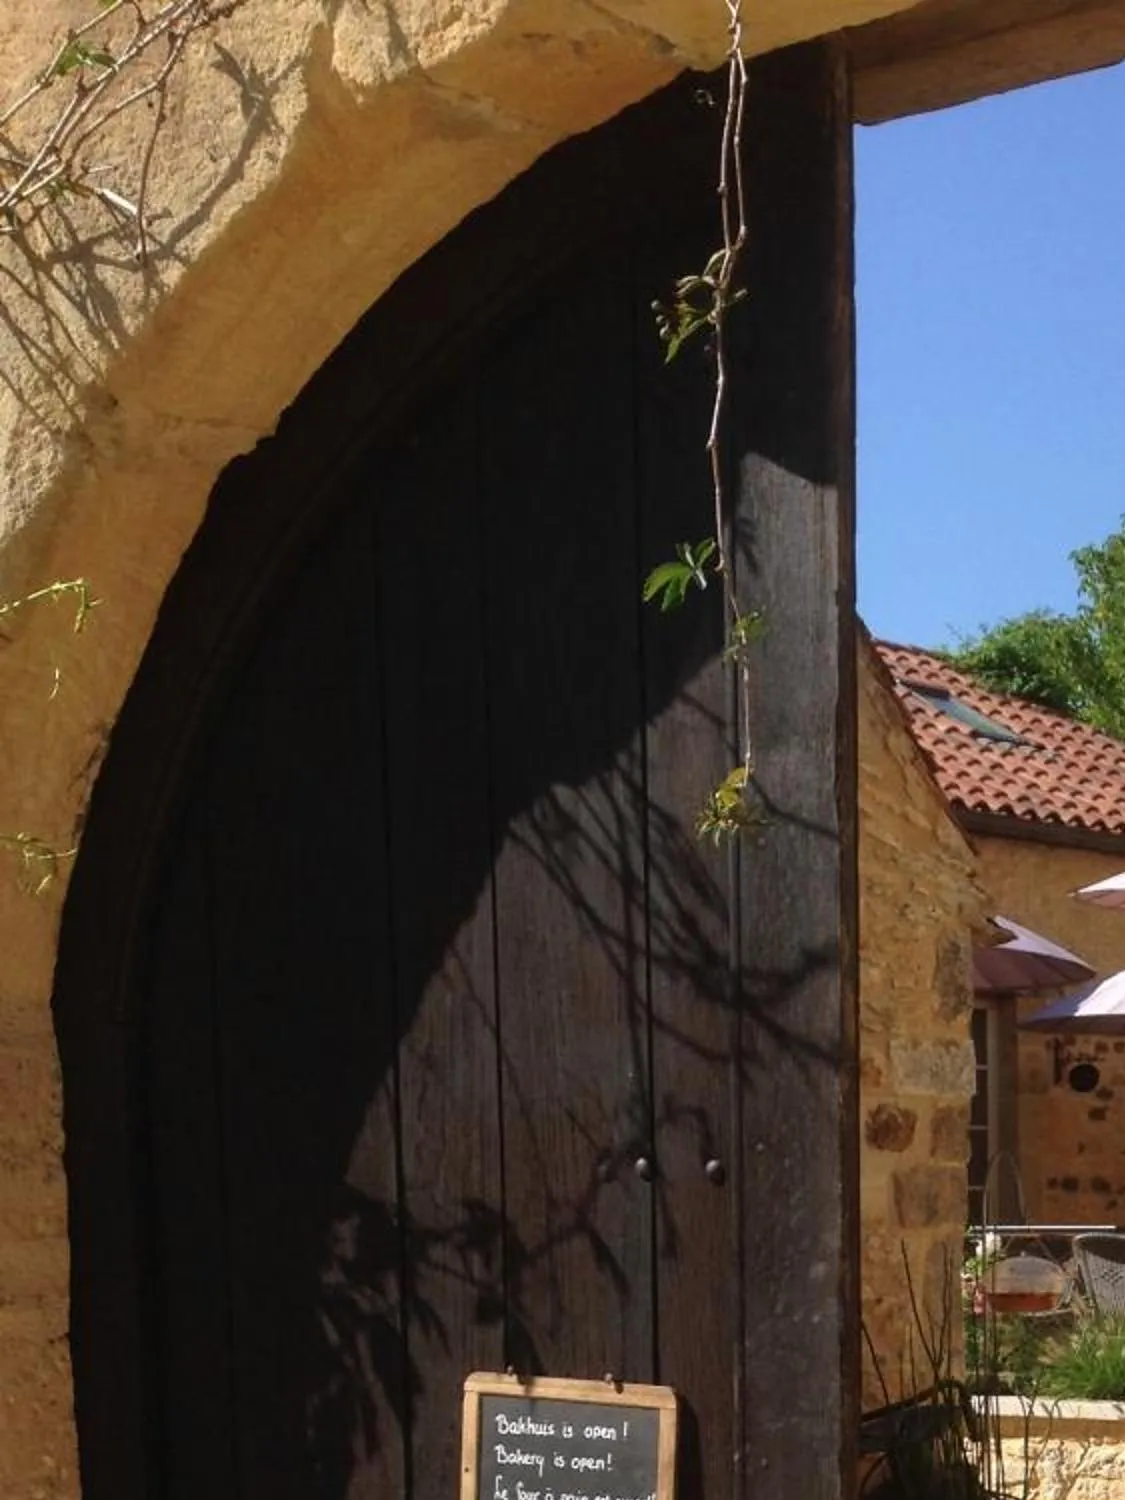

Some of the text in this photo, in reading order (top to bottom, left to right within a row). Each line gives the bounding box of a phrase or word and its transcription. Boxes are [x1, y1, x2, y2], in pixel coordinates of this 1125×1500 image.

[495, 1413, 556, 1436] Bakhuis
[562, 1421, 574, 1439] is
[583, 1424, 617, 1441] open
[494, 1444, 545, 1478] Bakery
[553, 1451, 566, 1469] is
